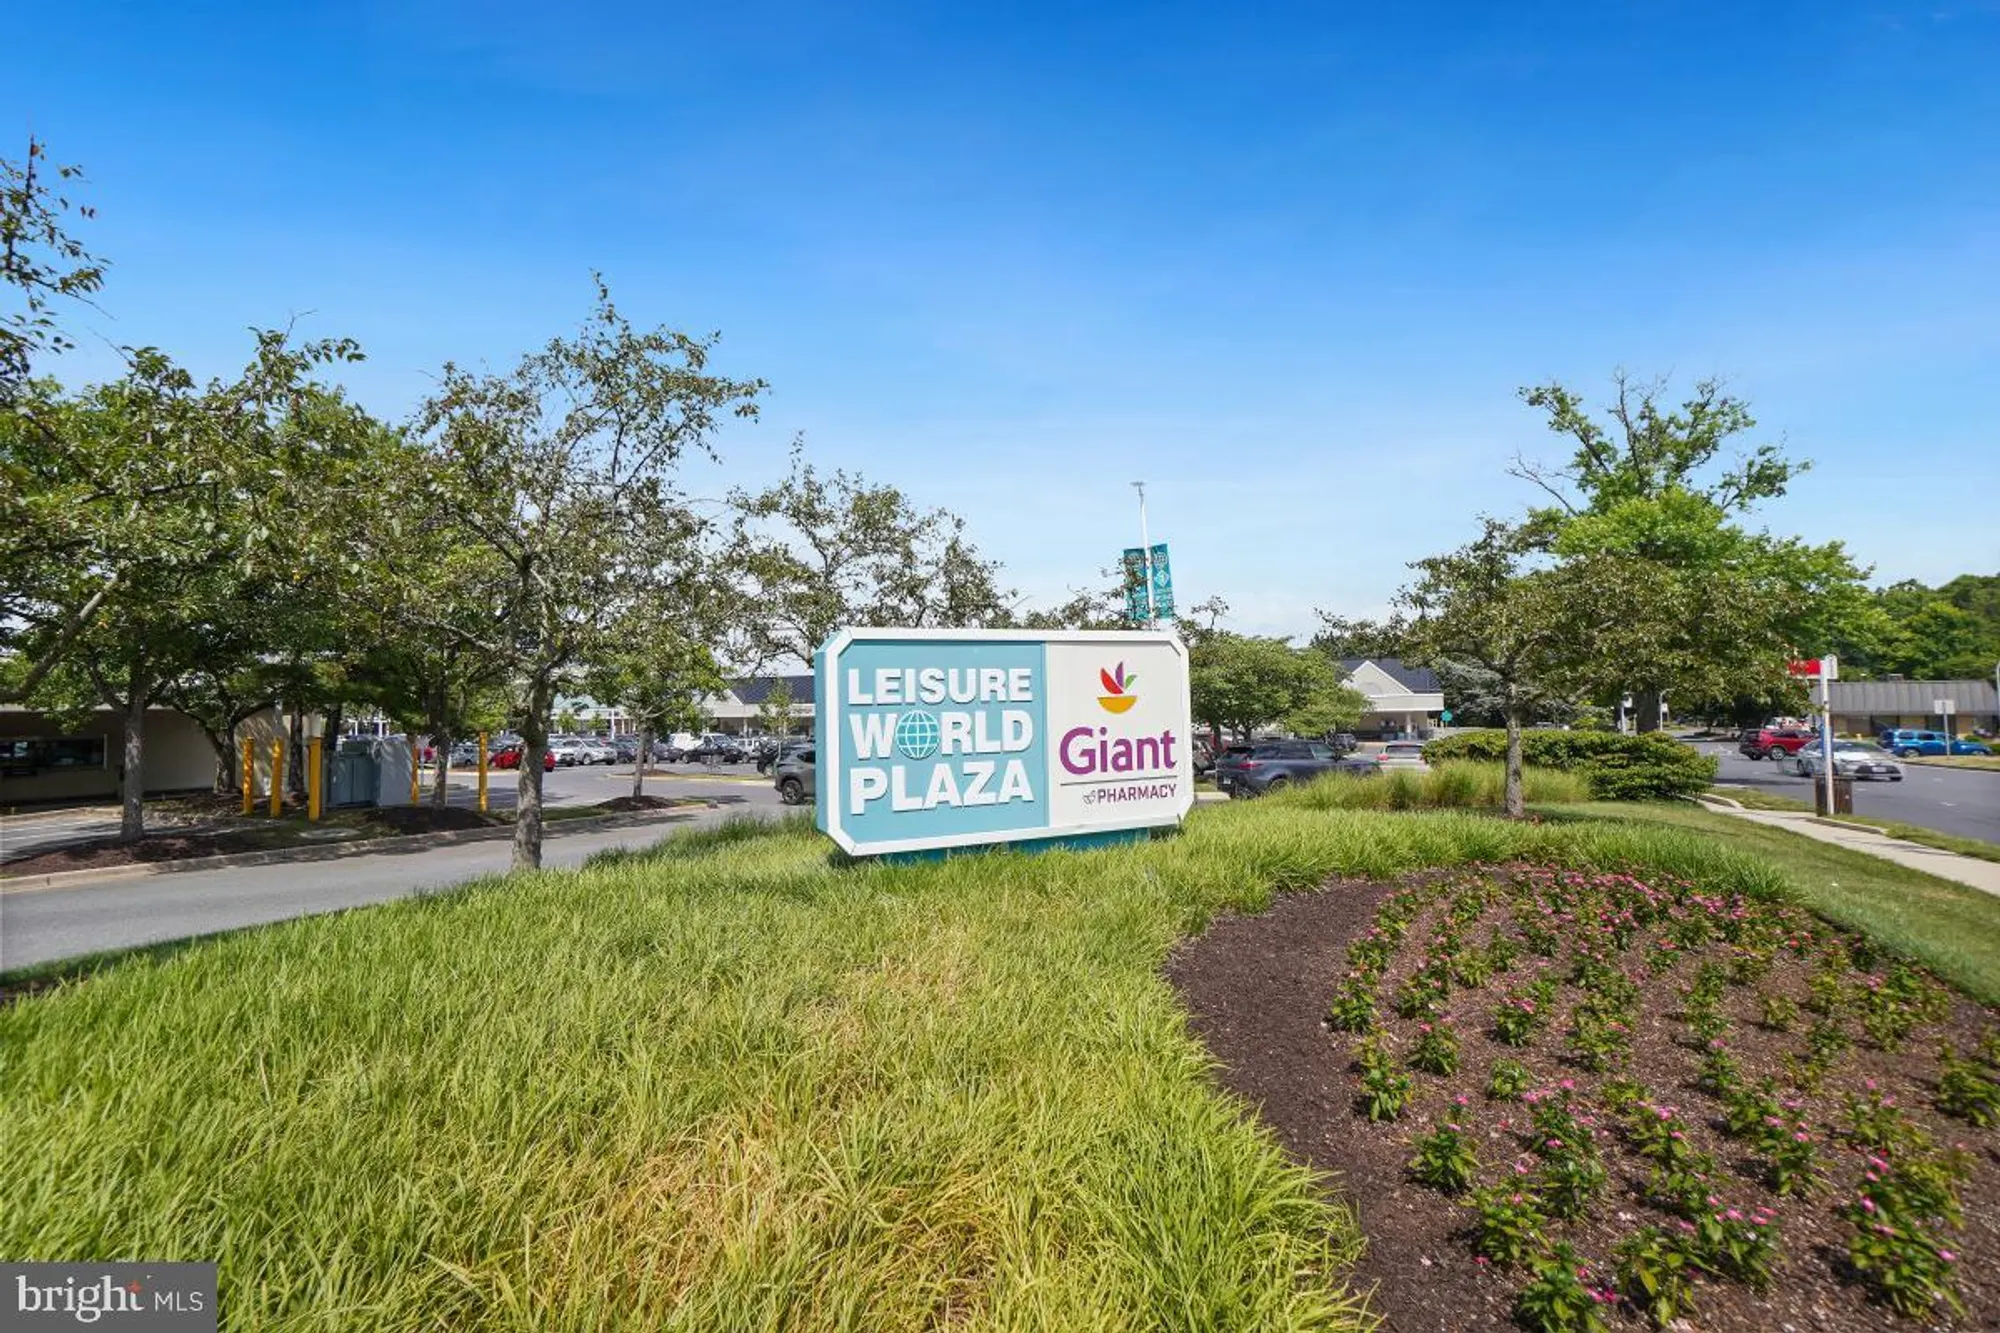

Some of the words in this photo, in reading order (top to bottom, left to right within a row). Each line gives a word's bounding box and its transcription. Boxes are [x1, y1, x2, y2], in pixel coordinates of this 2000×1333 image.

[847, 668, 1033, 705] LEISURE
[1059, 726, 1176, 775] Giant
[850, 759, 1035, 815] PLAZA
[1097, 783, 1177, 803] PHARMACY
